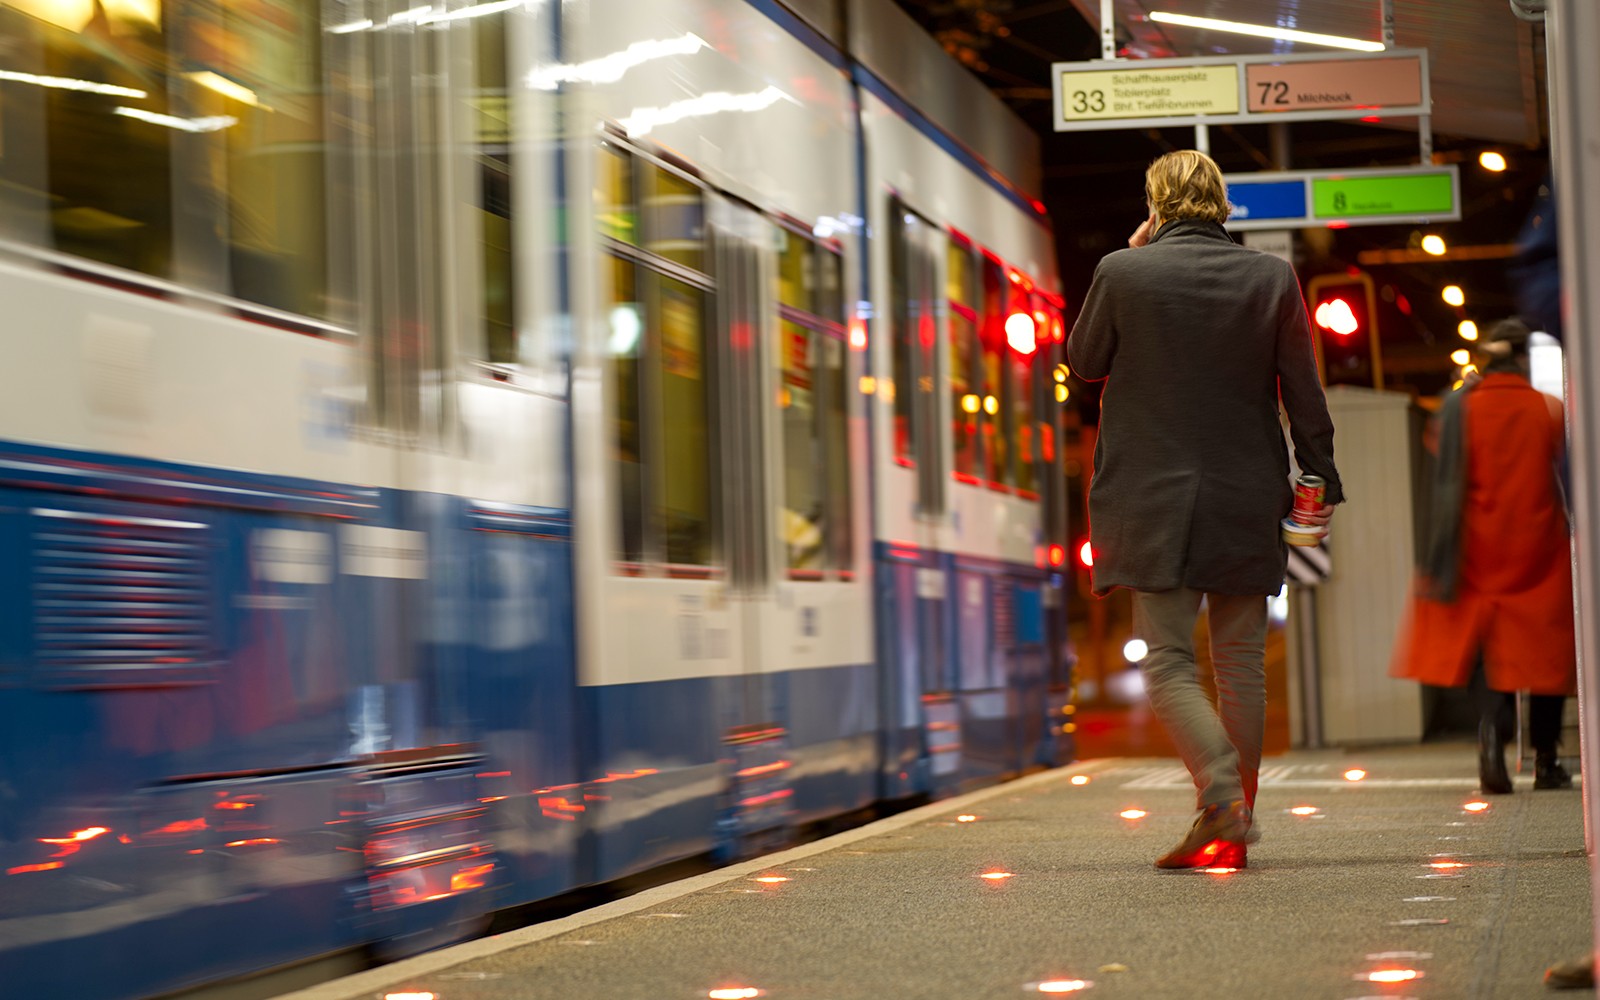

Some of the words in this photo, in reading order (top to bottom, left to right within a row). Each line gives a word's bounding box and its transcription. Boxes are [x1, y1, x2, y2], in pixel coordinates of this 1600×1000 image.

[1112, 72, 1207, 86] Schaffhauserplatz
[1073, 90, 1105, 113] 33
[1257, 81, 1289, 105] 72
[1297, 92, 1352, 104] Milchbuck
[1333, 191, 1347, 212] 8
